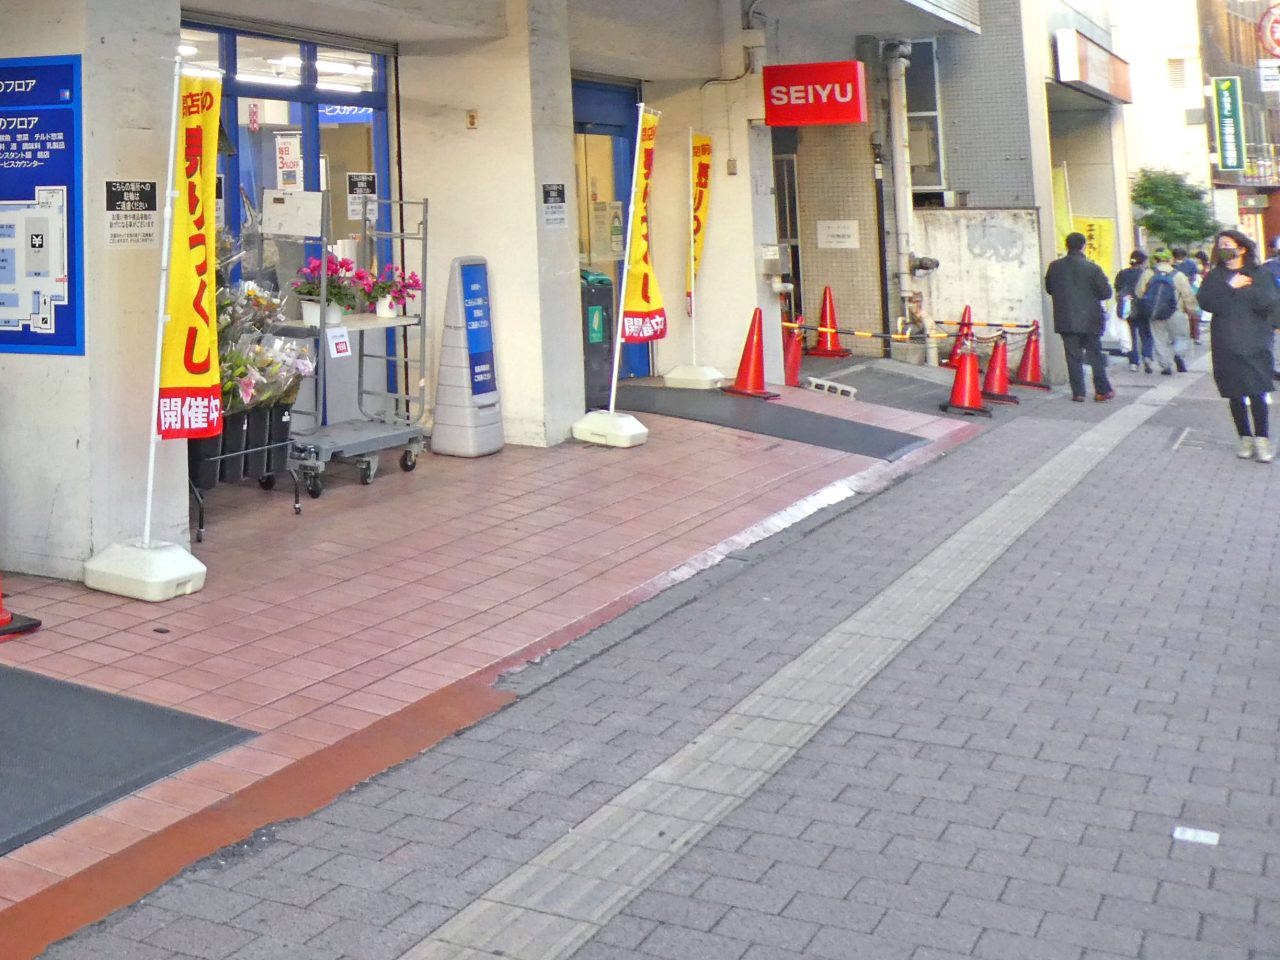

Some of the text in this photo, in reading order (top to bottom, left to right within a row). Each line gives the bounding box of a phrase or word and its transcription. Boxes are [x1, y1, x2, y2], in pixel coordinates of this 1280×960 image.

[770, 82, 853, 106] SEIYU
[160, 396, 220, 430] 開催中
